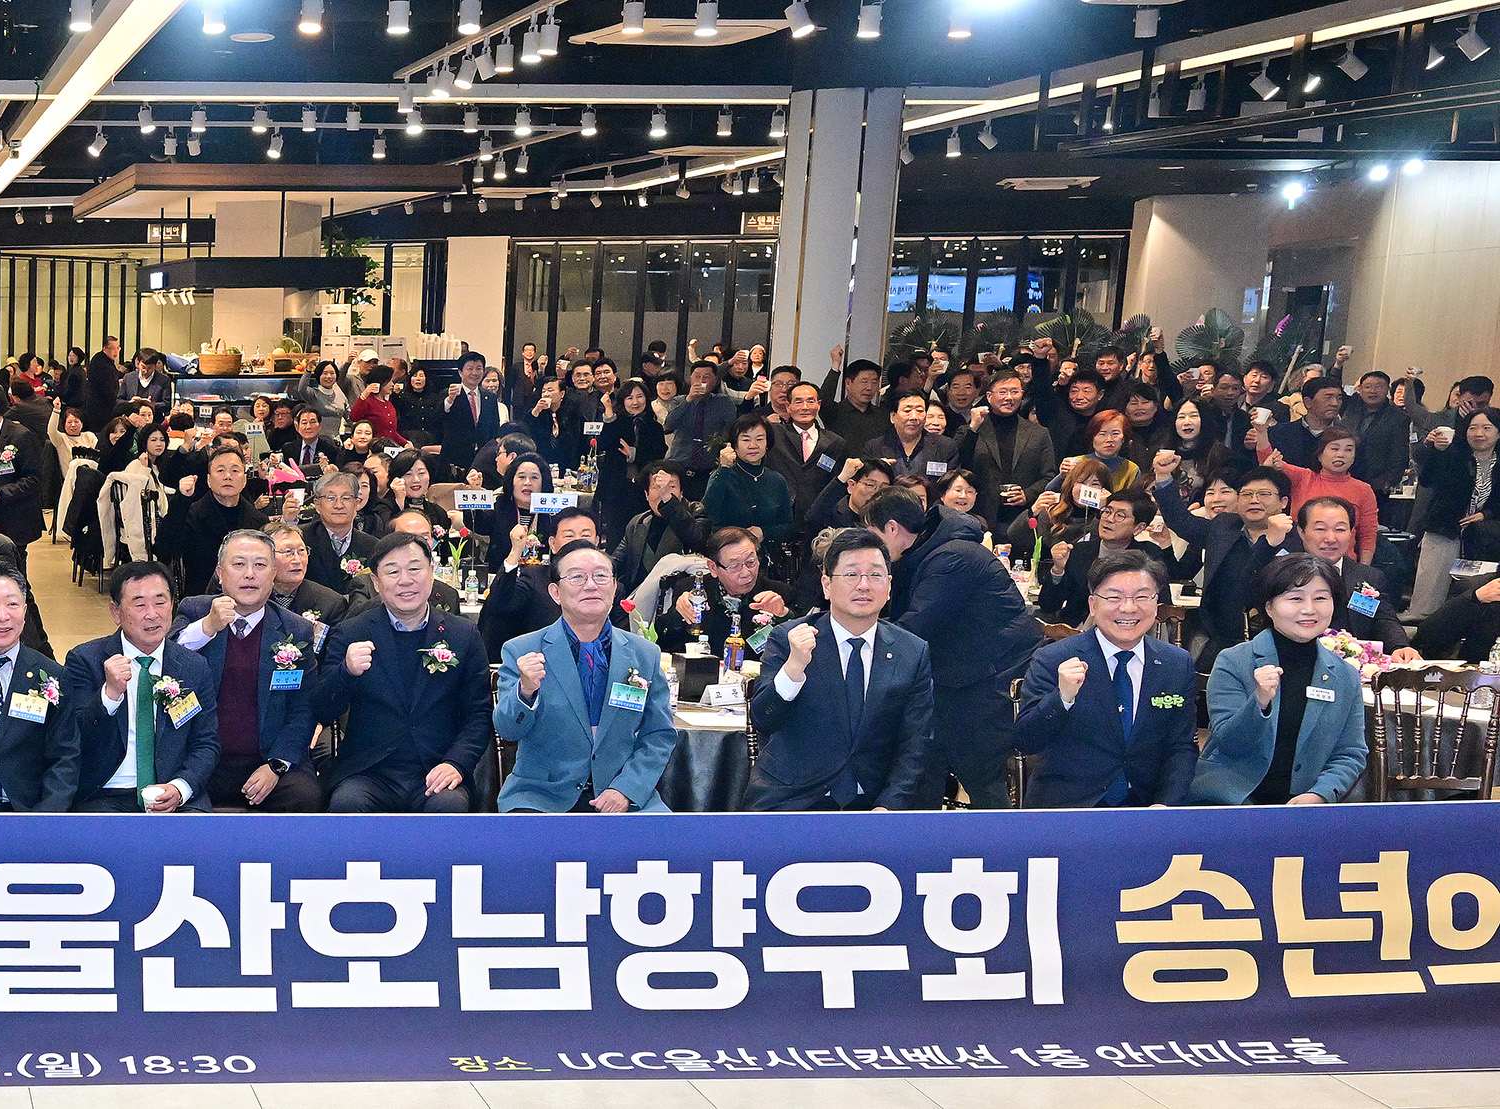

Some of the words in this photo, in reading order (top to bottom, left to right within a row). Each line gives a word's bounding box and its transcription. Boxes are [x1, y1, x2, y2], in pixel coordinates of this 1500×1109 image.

[461, 493, 488, 502] 전주시
[539, 496, 570, 506] 완주군
[557, 1045, 1010, 1073] UCC울산시티컨벤션
[1010, 1044, 1090, 1069] 1층
[1095, 1037, 1348, 1069] 안다미로홀
[120, 1055, 258, 1077] 18:30
